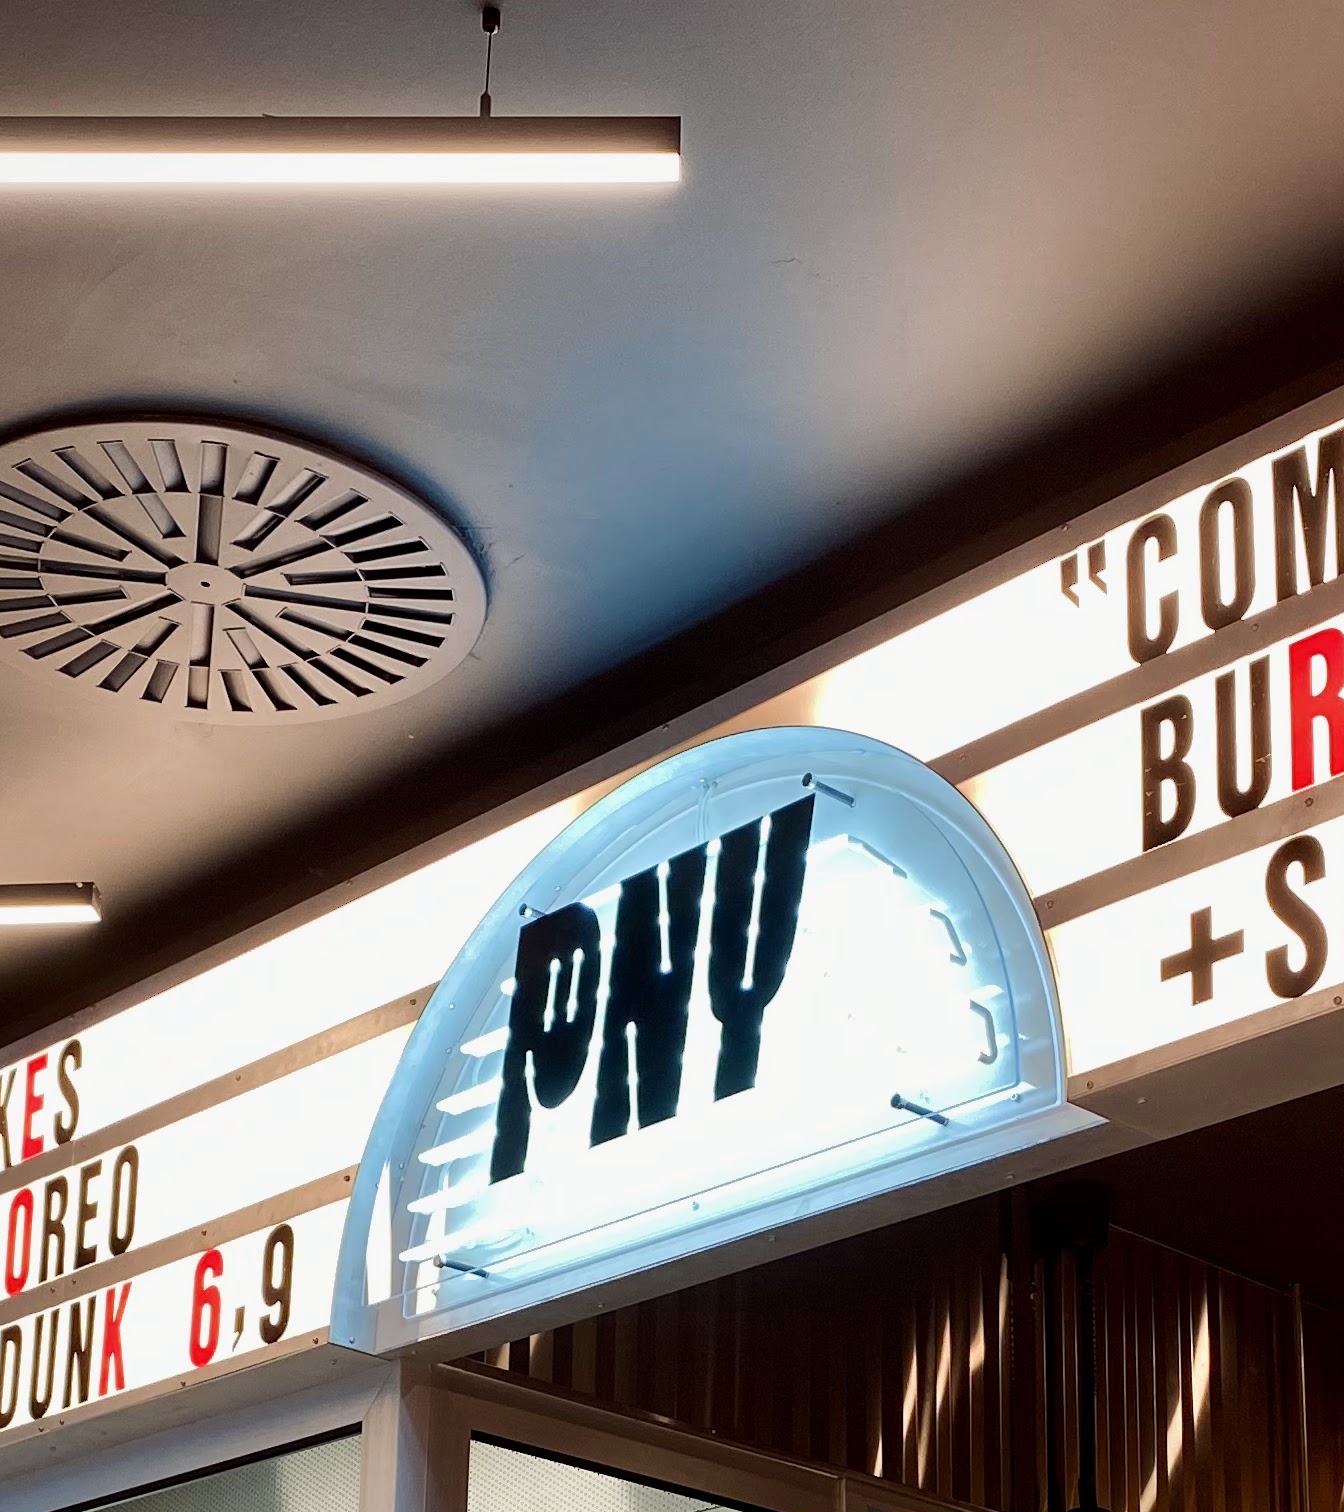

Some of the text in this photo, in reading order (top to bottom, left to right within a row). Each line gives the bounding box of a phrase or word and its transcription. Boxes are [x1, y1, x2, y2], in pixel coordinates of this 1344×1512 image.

[488, 793, 816, 1187] PNY
[4, 1144, 141, 1297] OREO
[187, 1222, 297, 1370] 6,9
